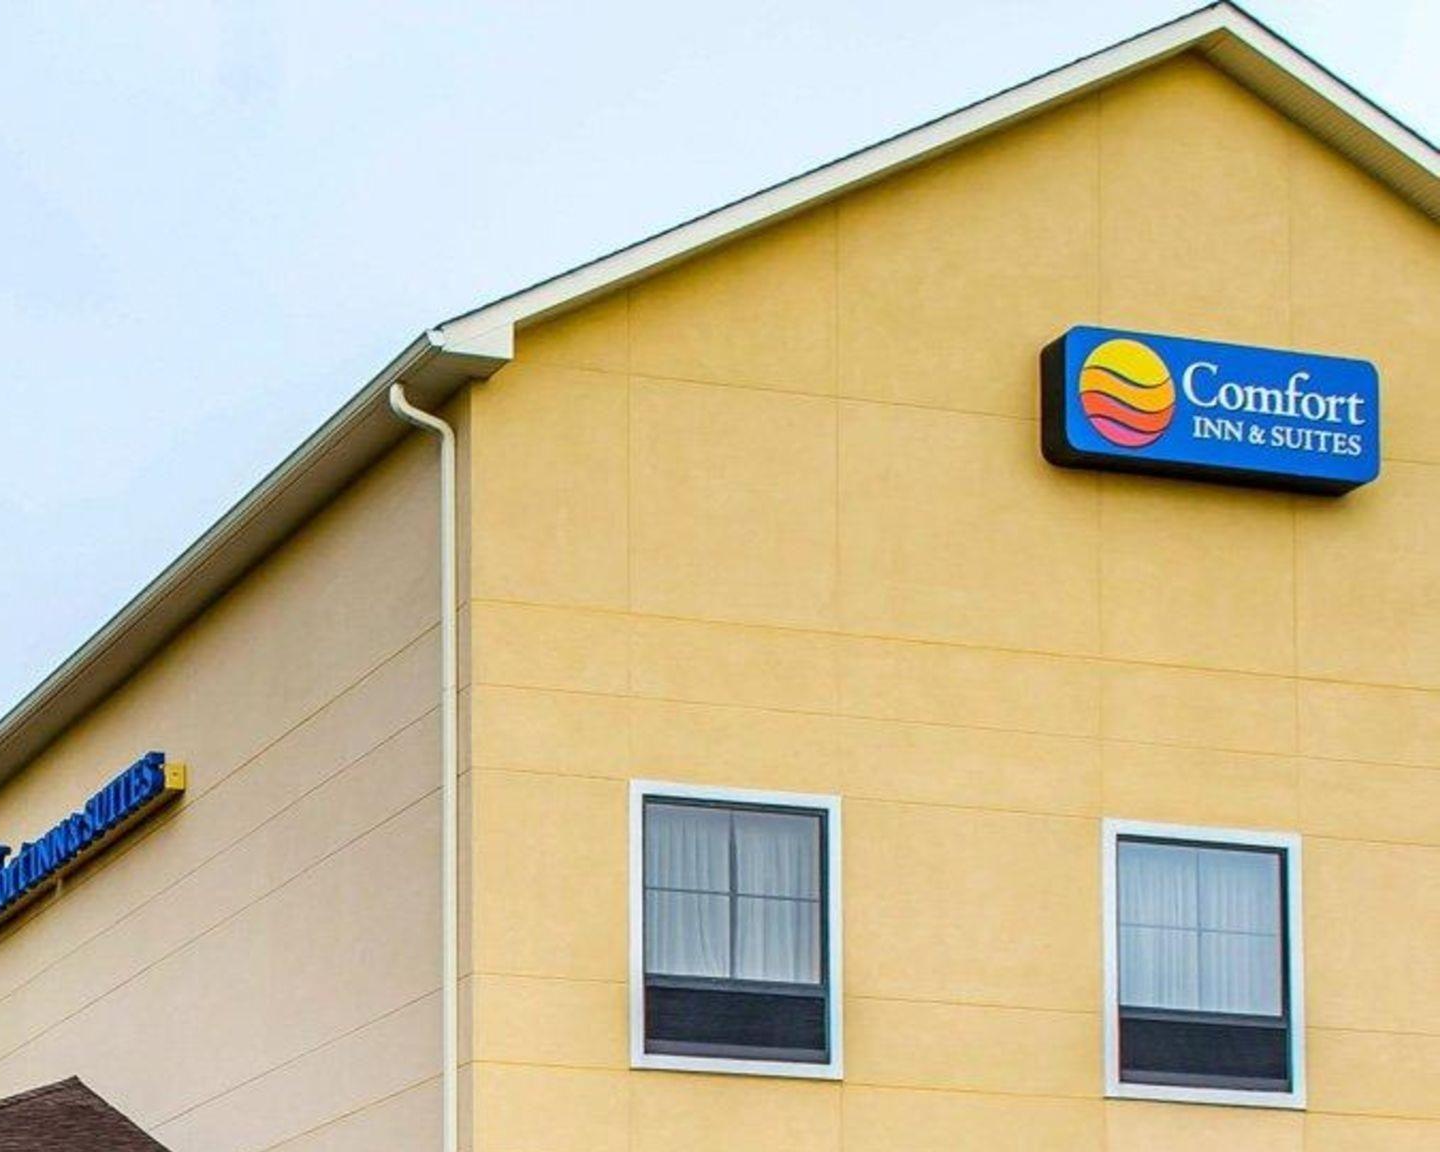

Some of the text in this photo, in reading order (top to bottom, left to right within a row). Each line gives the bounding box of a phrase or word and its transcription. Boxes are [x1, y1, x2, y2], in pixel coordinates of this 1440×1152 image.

[1182, 362, 1365, 425] Comfort
[1193, 416, 1361, 456] INN & SUITES
